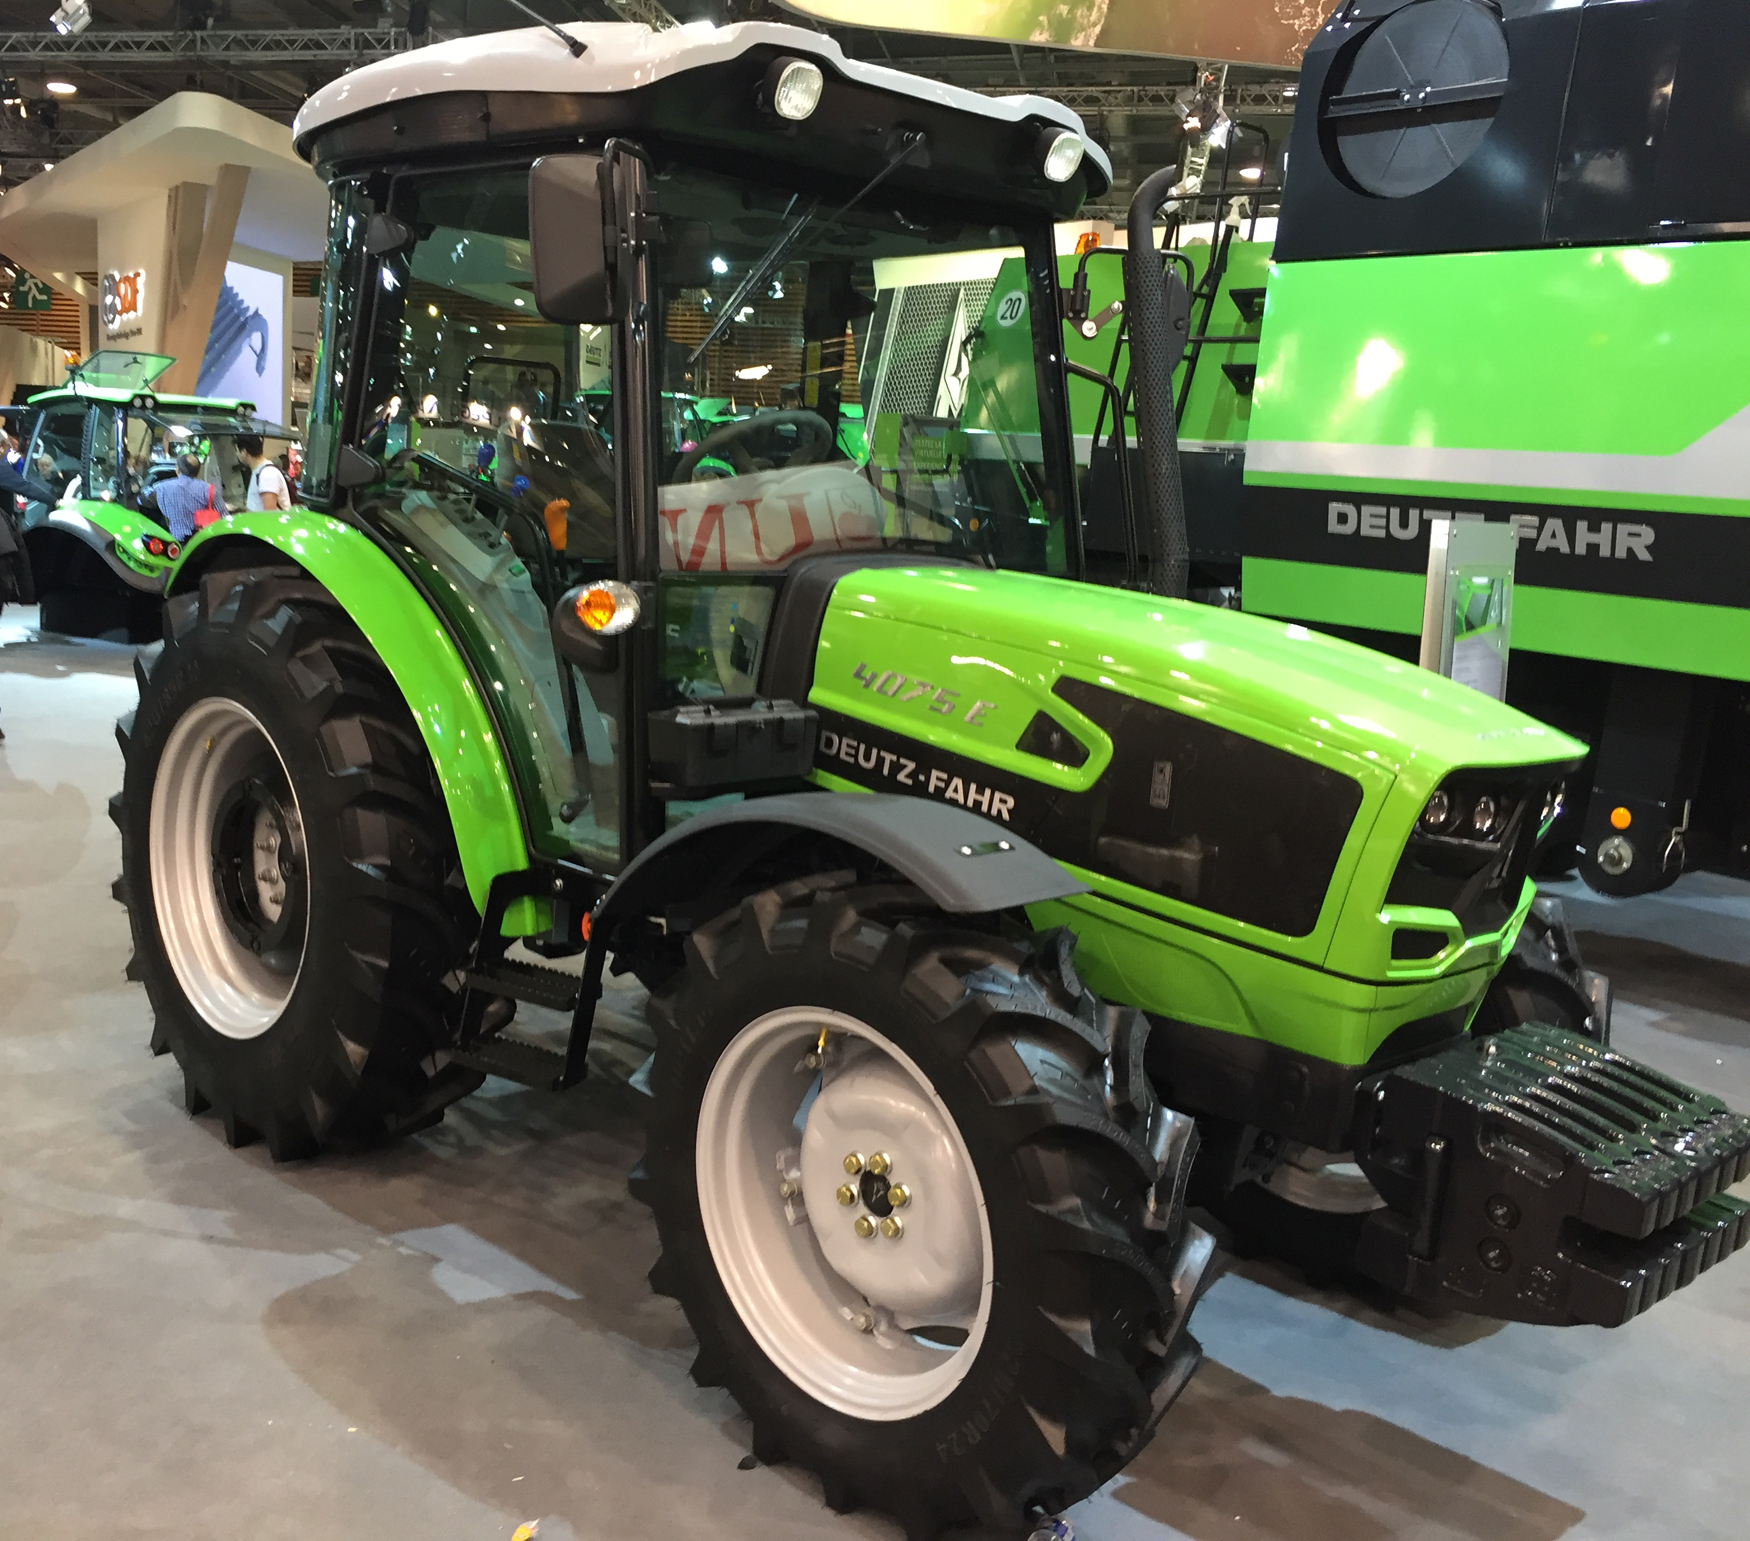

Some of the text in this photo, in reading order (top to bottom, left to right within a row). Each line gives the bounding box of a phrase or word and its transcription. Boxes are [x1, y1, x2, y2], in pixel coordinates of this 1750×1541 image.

[1000, 297, 1022, 320] 20
[853, 662, 998, 727] 4075 E
